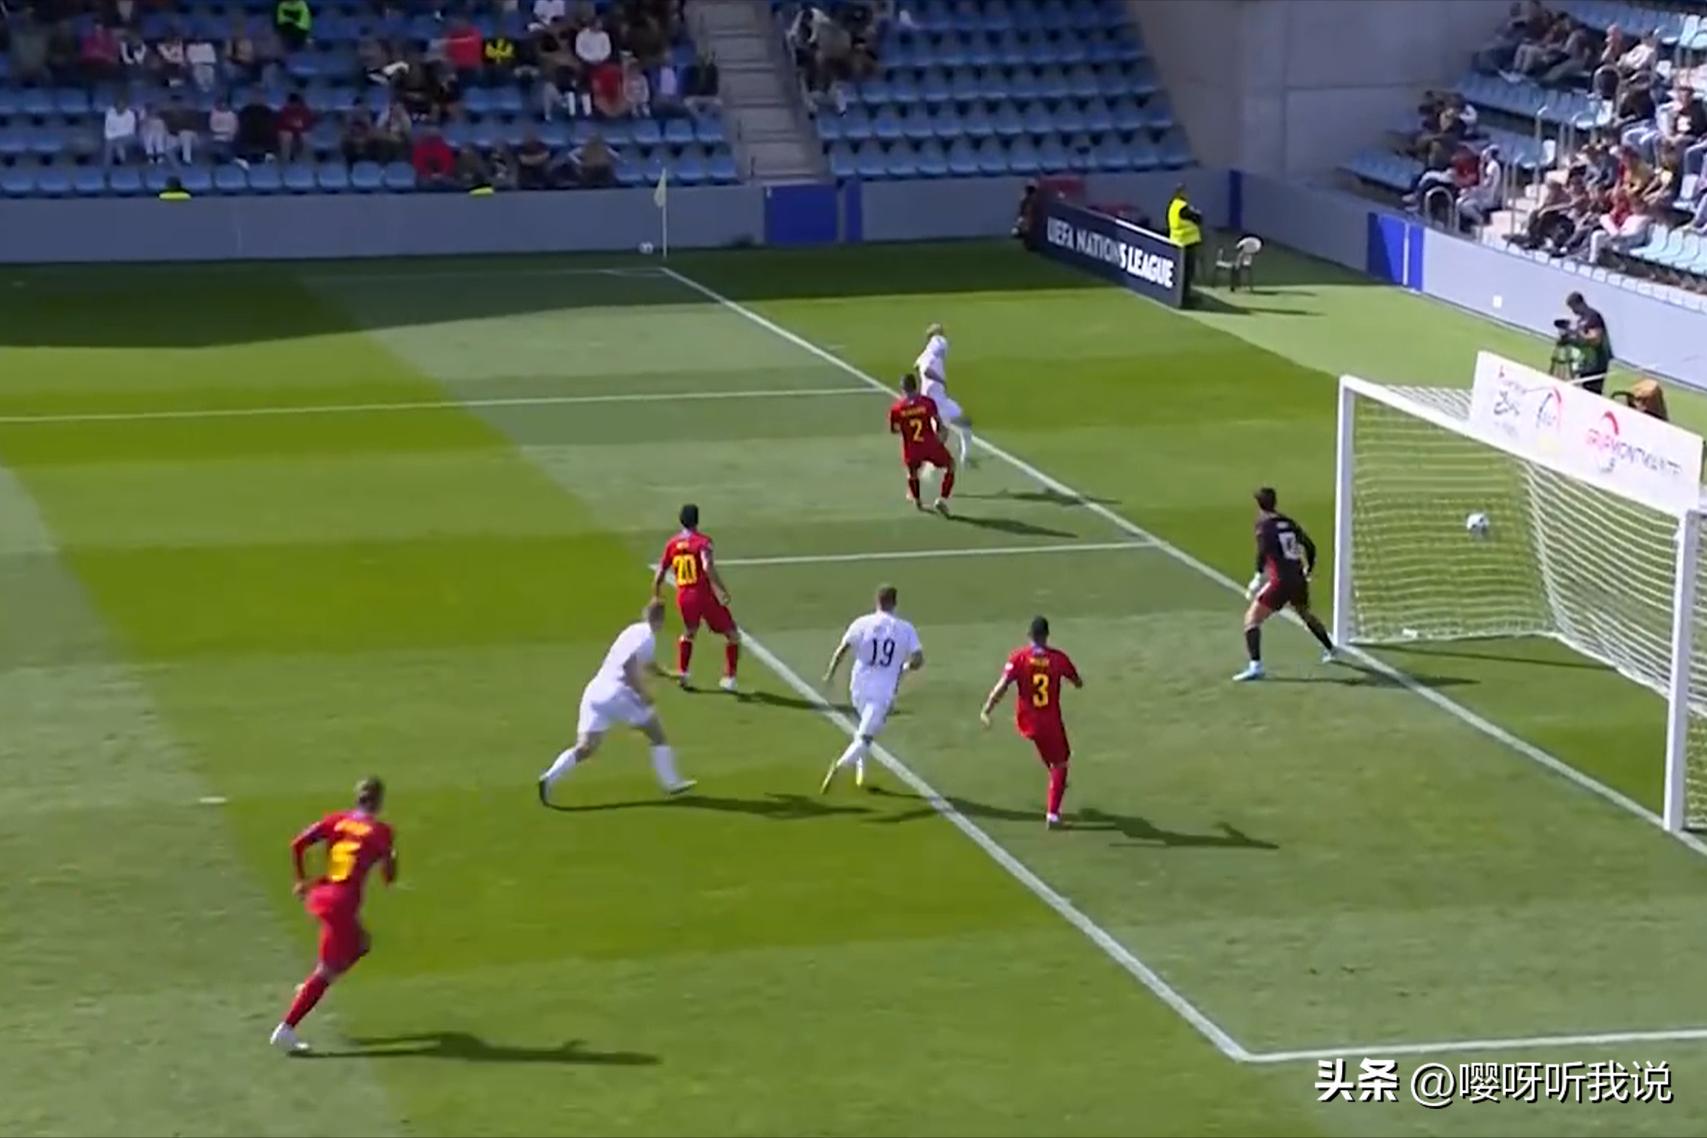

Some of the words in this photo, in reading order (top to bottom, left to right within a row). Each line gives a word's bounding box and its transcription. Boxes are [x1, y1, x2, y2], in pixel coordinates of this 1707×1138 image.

[1047, 216, 1074, 250] UEFA
[1076, 229, 1127, 269] NATIONS
[1127, 245, 1174, 289] LEAGUE
[909, 418, 925, 442] 2
[672, 554, 698, 586] 20
[869, 637, 896, 668] 19
[1032, 673, 1049, 707] 3
